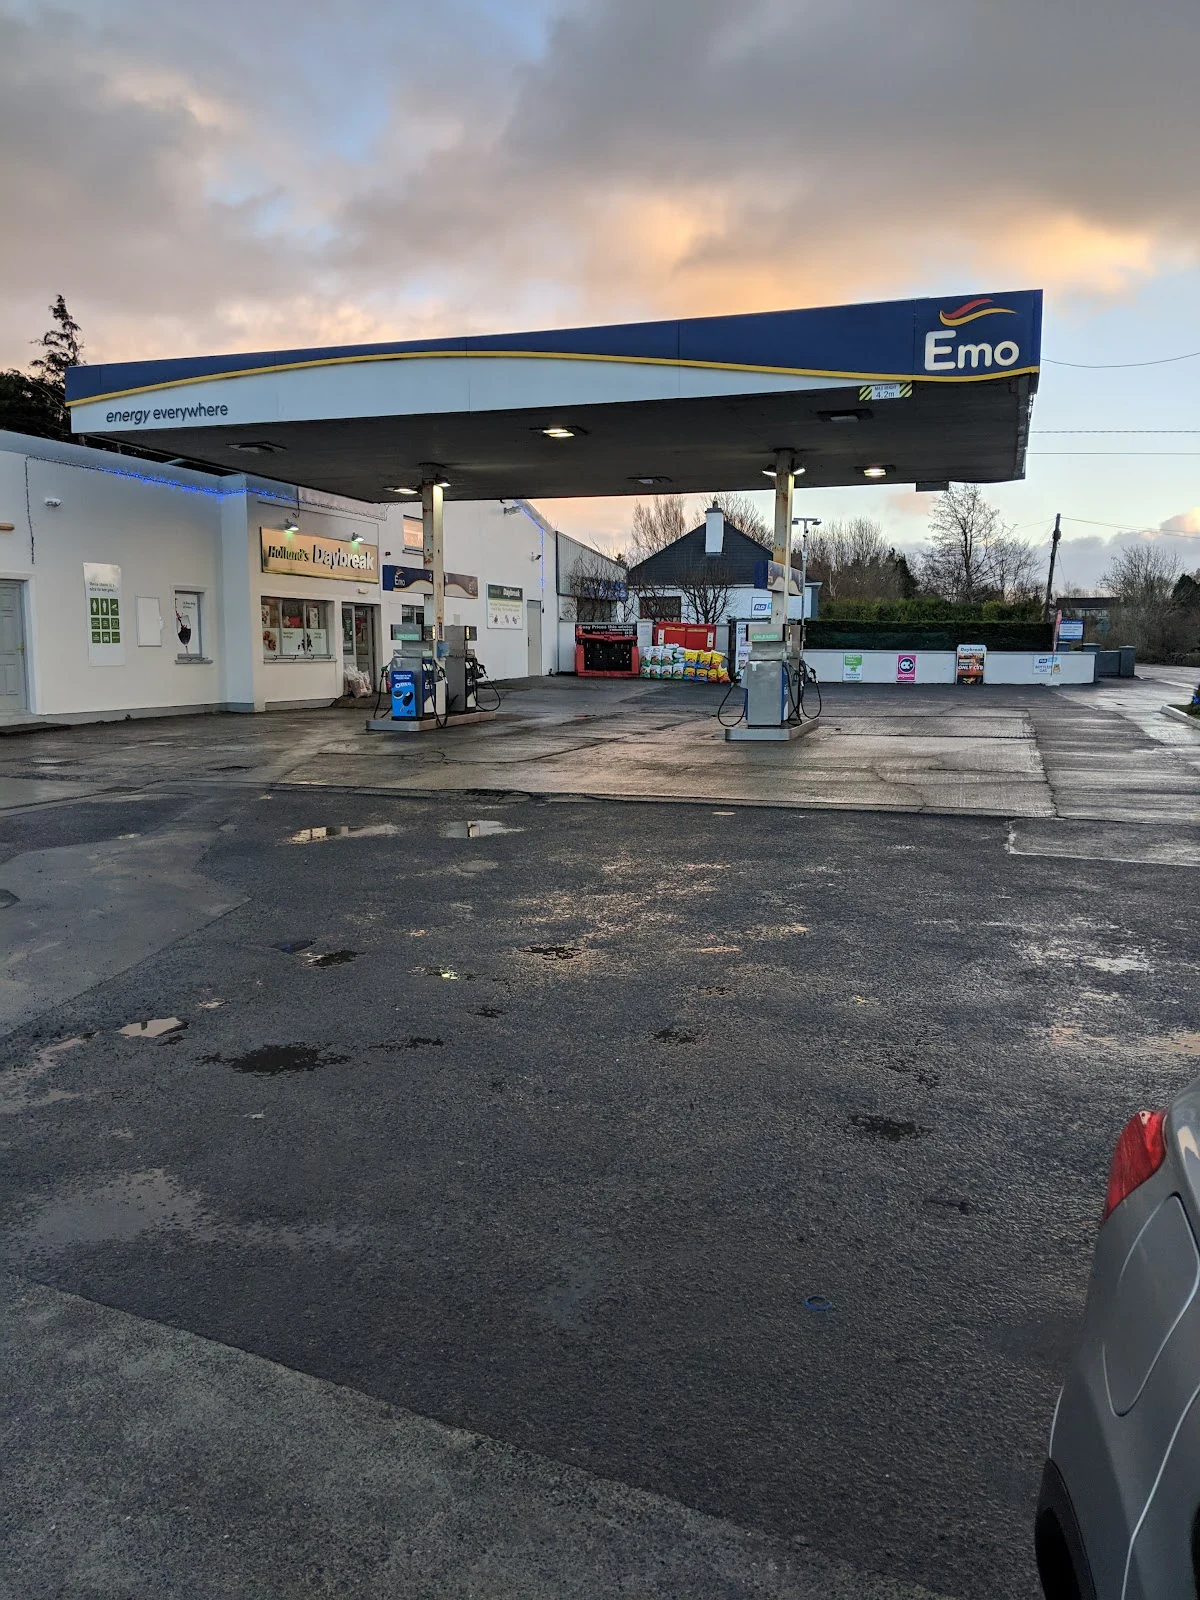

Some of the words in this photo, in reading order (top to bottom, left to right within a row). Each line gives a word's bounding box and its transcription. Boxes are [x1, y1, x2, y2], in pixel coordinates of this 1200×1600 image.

[924, 329, 1020, 371] Emo
[875, 390, 895, 399] 4.2m
[106, 410, 150, 425] energy
[153, 402, 229, 421] everywhere
[267, 545, 309, 562] Holland's
[312, 544, 374, 571] Daybreak
[394, 575, 406, 587] Emo
[428, 573, 433, 582] 2
